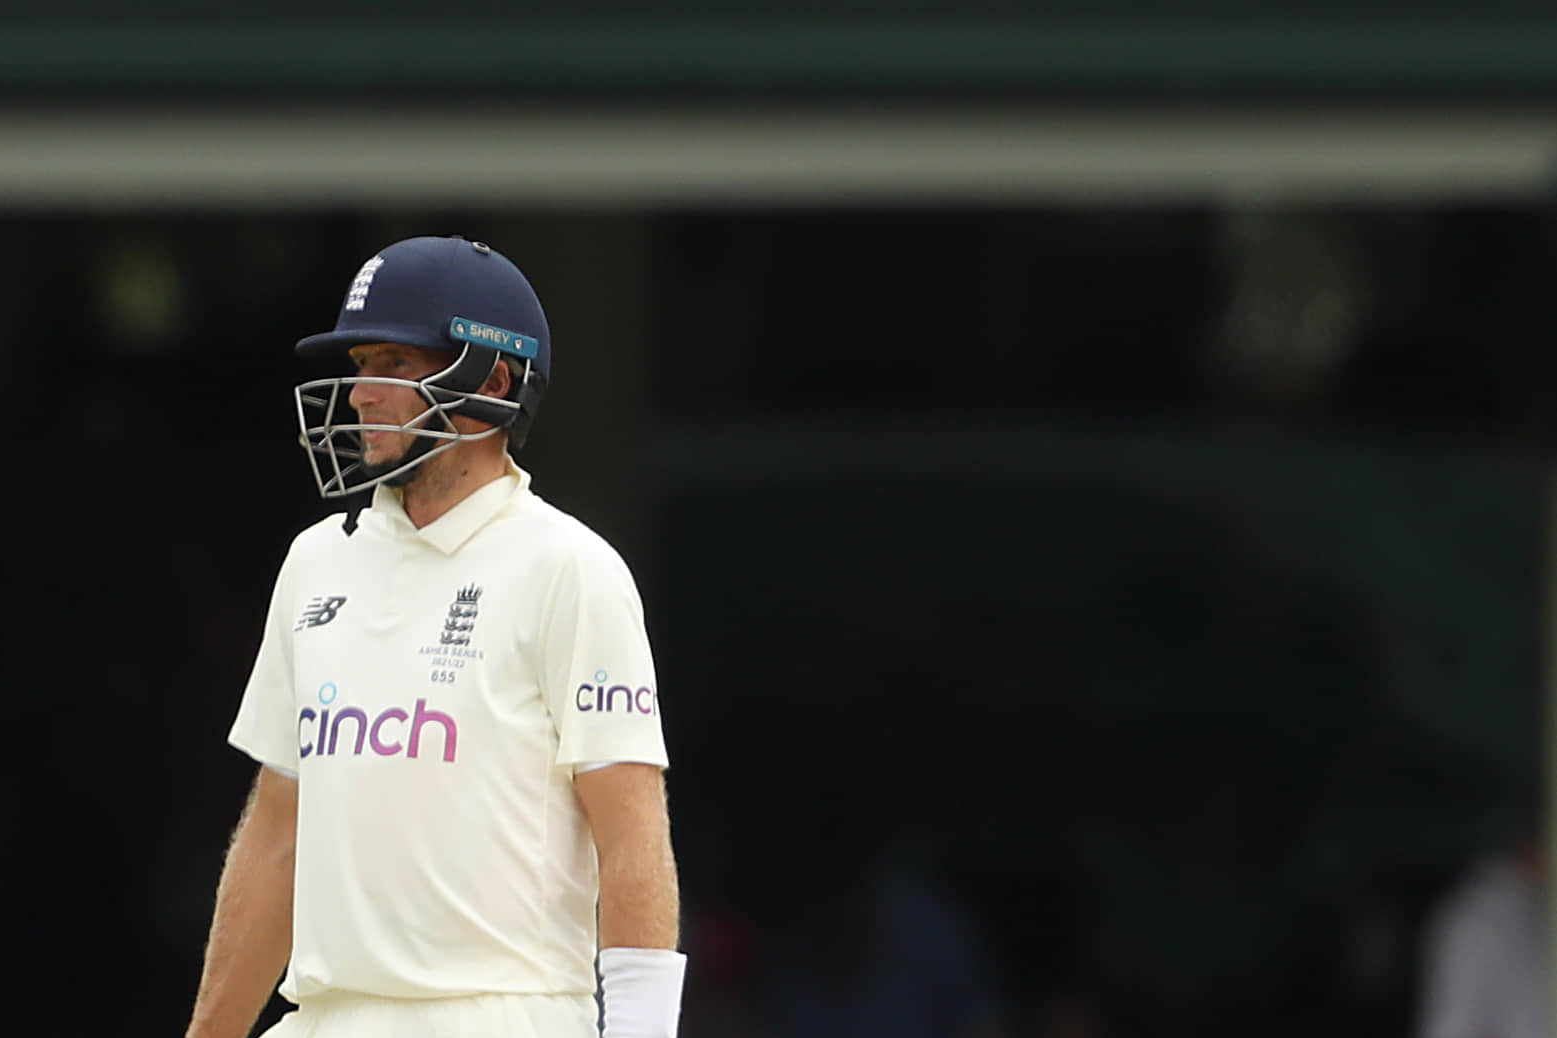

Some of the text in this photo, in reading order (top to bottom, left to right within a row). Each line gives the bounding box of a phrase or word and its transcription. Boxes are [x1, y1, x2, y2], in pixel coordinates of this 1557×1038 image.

[470, 324, 510, 344] SHREY
[430, 670, 456, 683] 655
[298, 682, 458, 763] cinch
